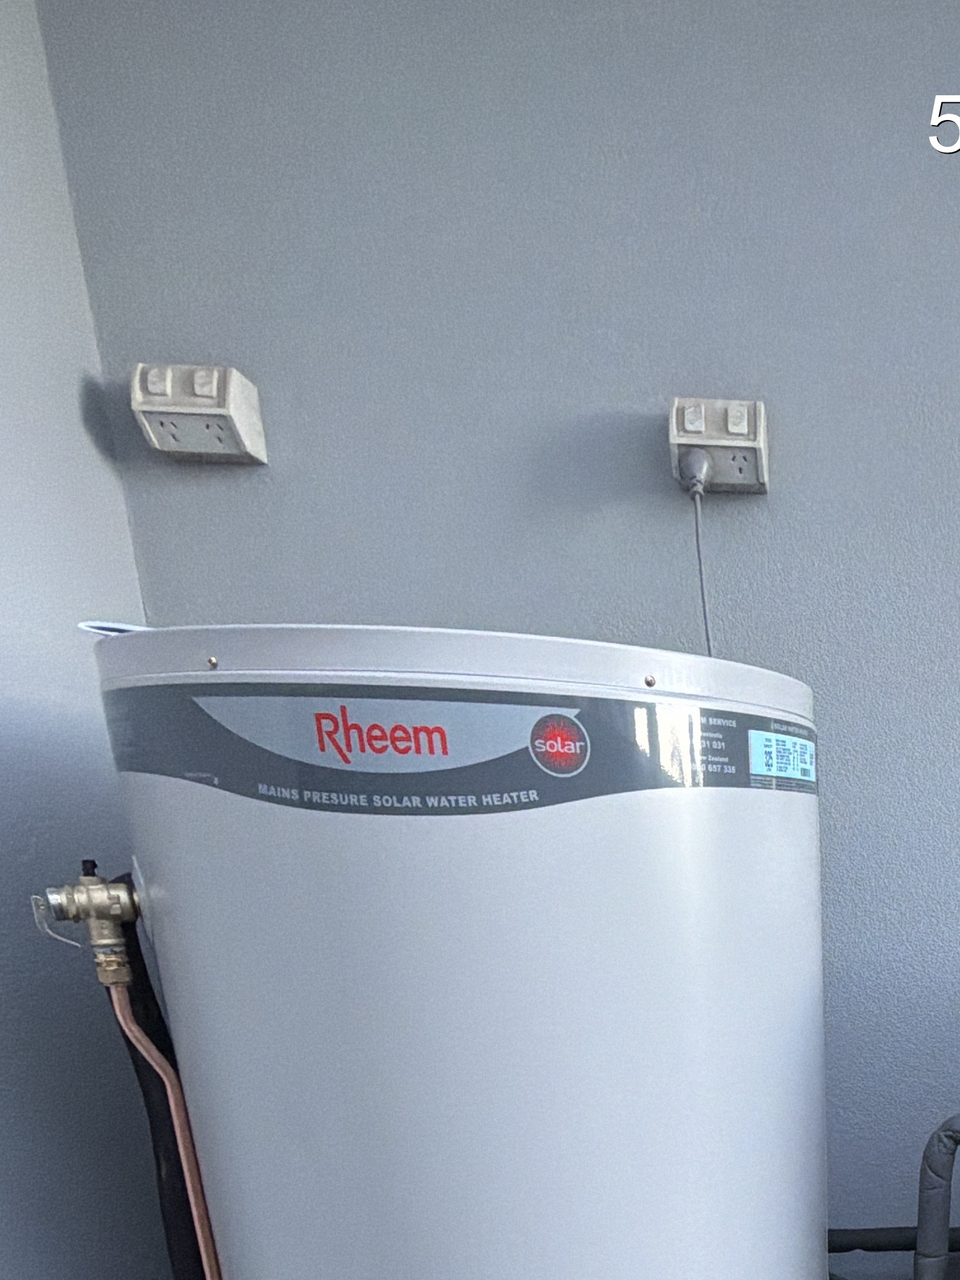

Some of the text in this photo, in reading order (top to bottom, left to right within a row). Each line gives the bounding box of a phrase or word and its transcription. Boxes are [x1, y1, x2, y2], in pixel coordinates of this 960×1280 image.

[315, 705, 449, 764] Rheem
[534, 735, 585, 755] solar
[257, 783, 540, 809] MAINS PRESURE SOLAR WATER HEATER
